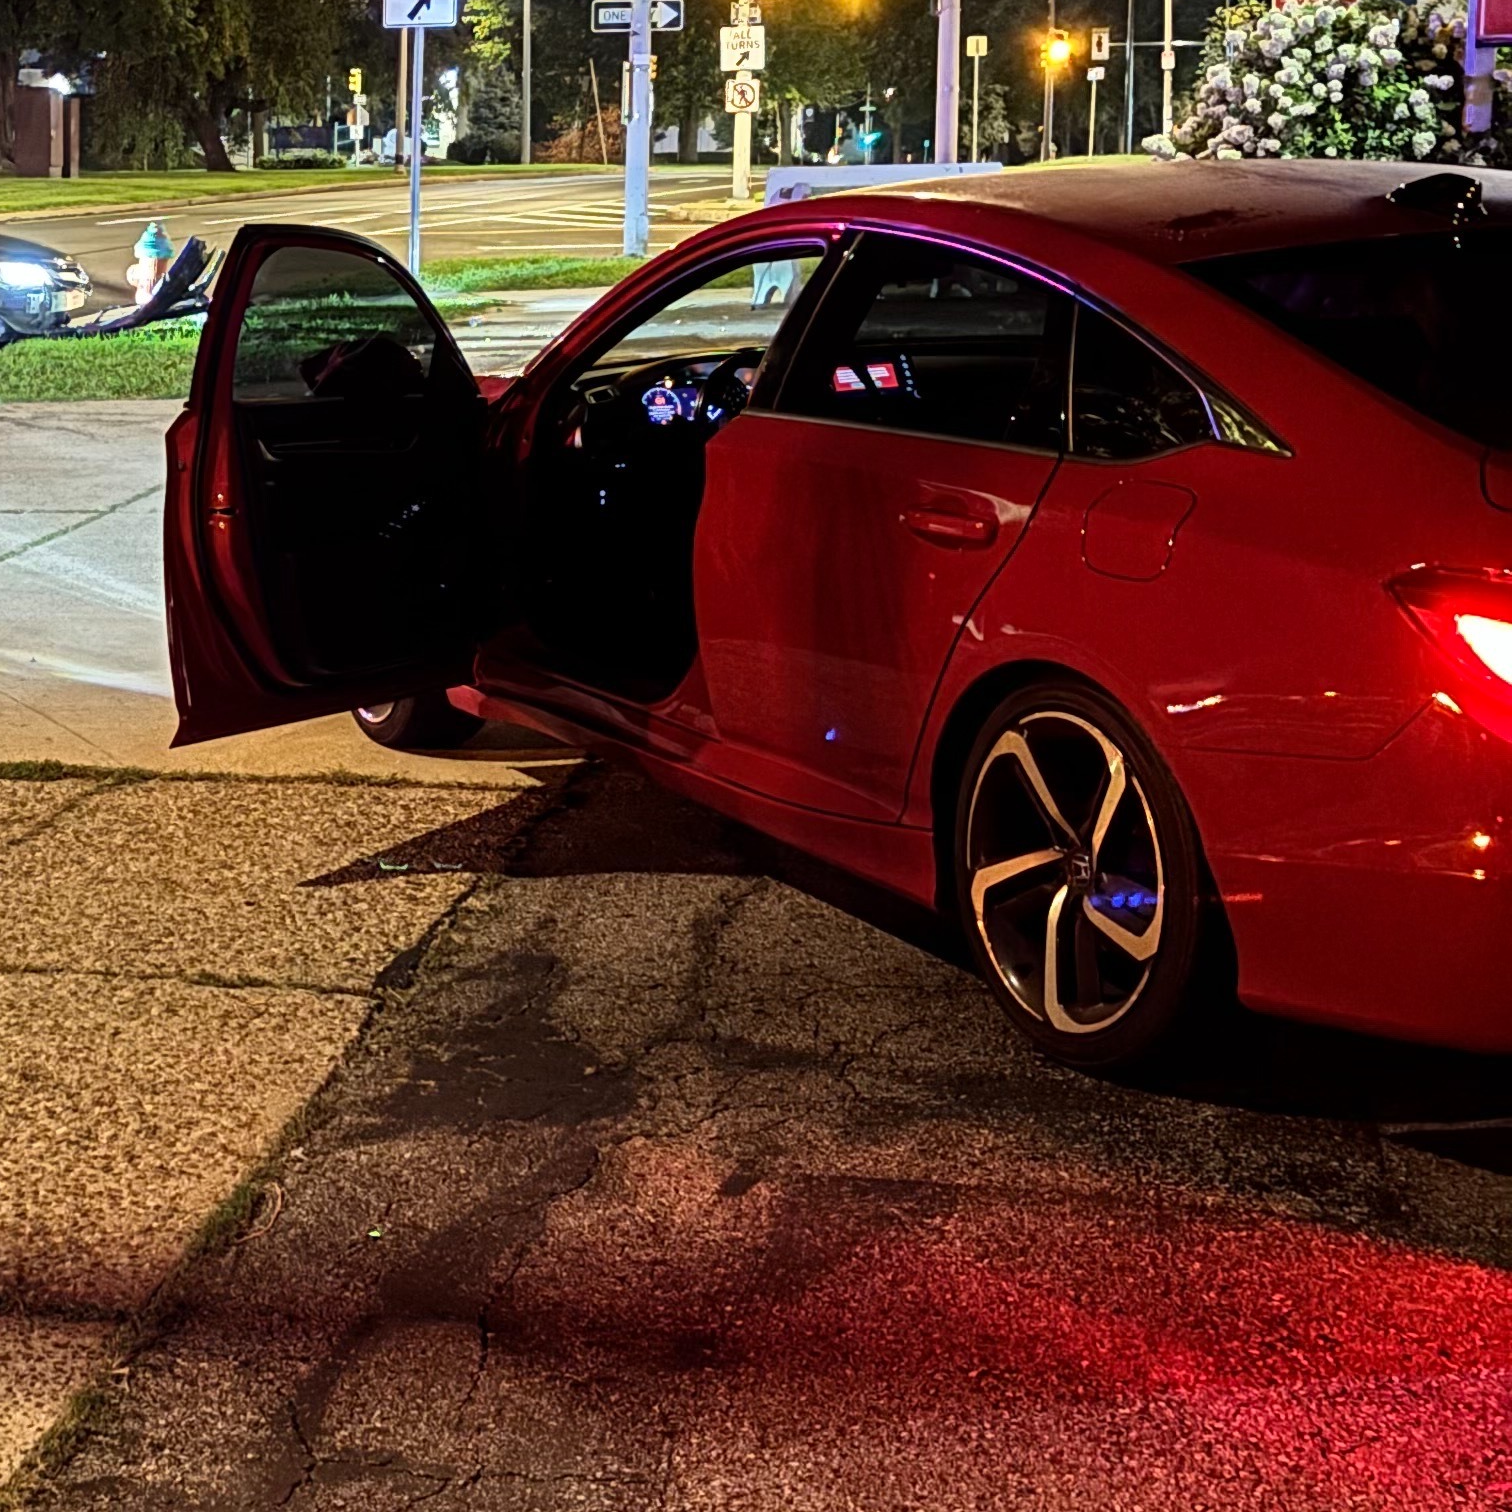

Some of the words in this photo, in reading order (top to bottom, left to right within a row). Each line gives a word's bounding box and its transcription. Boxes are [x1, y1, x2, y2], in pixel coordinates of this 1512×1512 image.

[603, 9, 626, 22] ONE
[733, 28, 752, 40] ALL
[726, 40, 760, 50] TURNS
